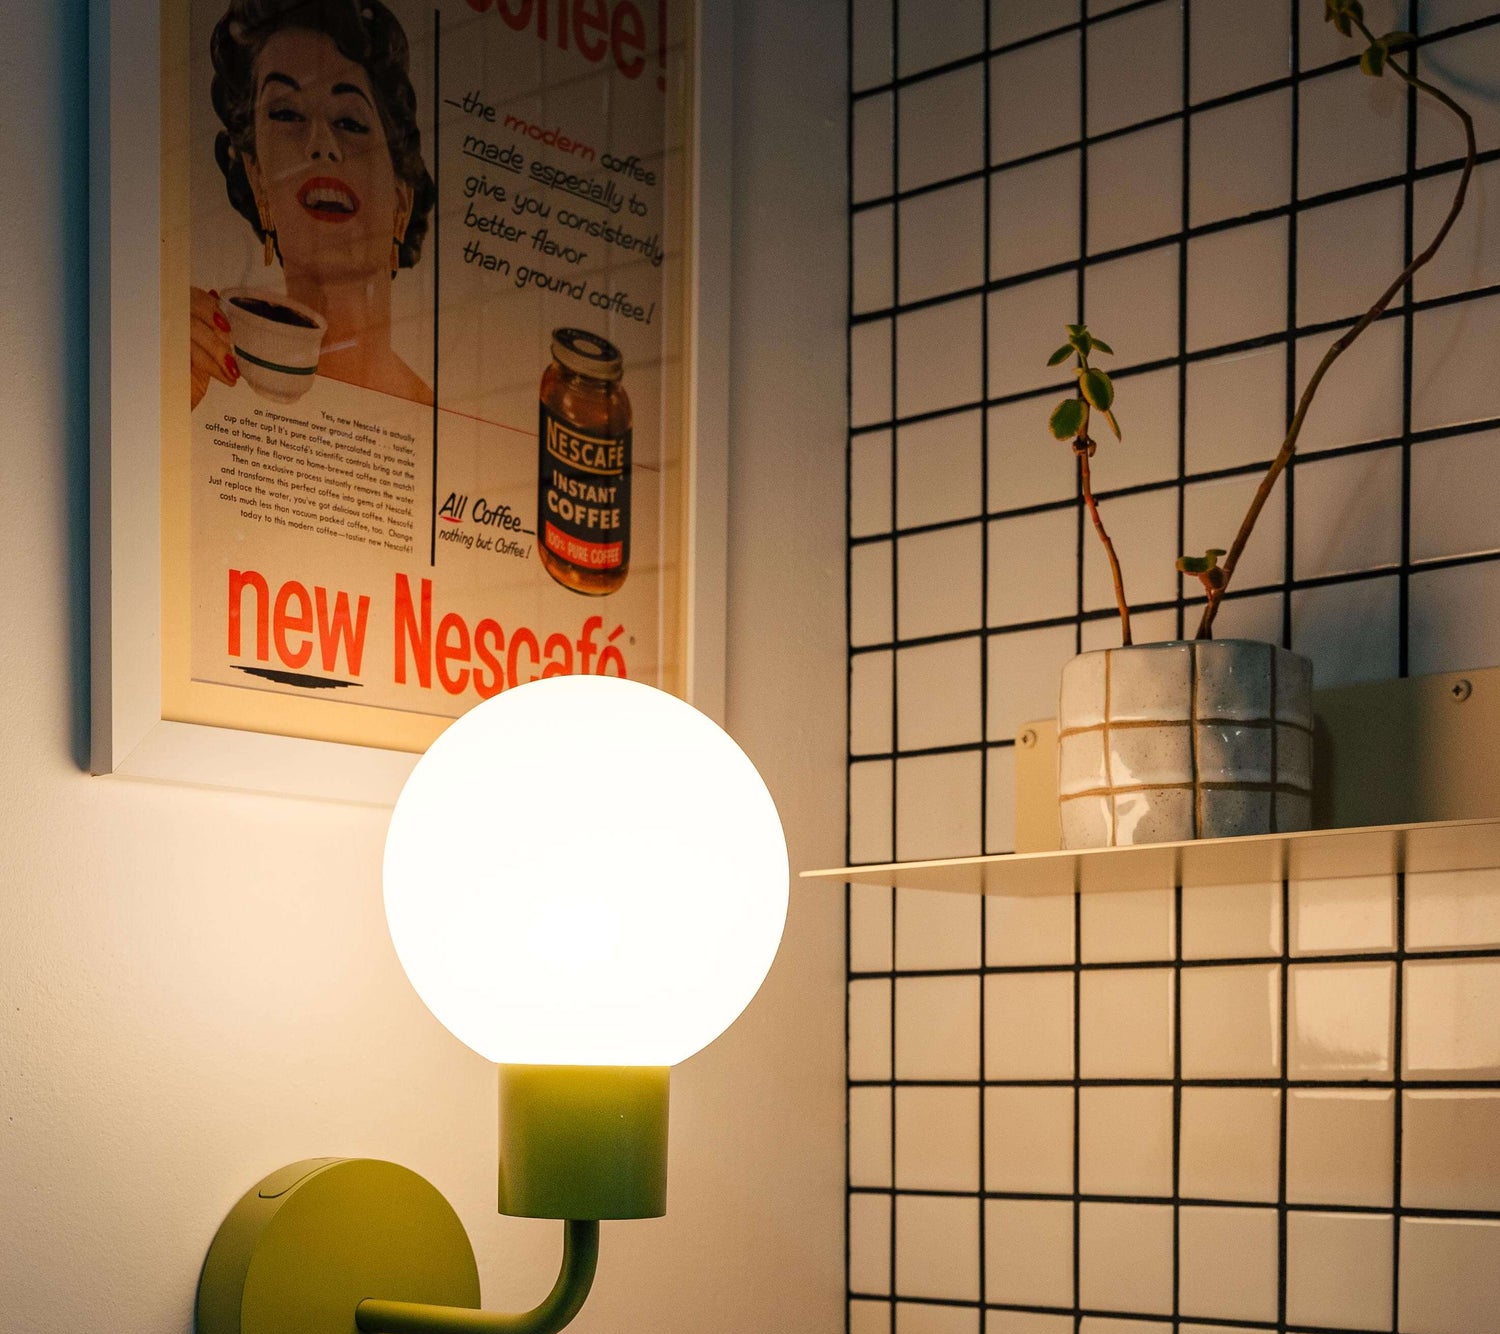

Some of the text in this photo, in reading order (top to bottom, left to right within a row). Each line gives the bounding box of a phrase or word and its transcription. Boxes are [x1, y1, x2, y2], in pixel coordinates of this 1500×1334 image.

[504, 114, 597, 162] modern
[601, 153, 657, 186] coffee
[463, 134, 648, 217] made especially to
[463, 175, 665, 267] give you consistently
[463, 202, 588, 265] better flavor
[463, 240, 656, 325] than ground coffee!
[205, 423, 229, 434] coffee
[242, 431, 264, 442] home.
[266, 436, 277, 445] But
[315, 450, 344, 463] scientific
[346, 457, 370, 469] controls
[373, 463, 390, 476] bring
[405, 471, 414, 479] the
[224, 415, 237, 424] cup
[240, 418, 257, 427] after
[260, 424, 276, 432] cup!
[290, 431, 306, 440] pure
[309, 436, 333, 448] coffee,
[335, 442, 371, 456] percolated
[384, 455, 395, 463] you
[397, 458, 415, 468] make
[265, 410, 309, 427] improvement
[311, 423, 327, 432] over
[329, 428, 352, 439] ground
[355, 435, 376, 445] coffee
[321, 410, 335, 423] Yes,
[337, 417, 351, 425] new
[390, 431, 415, 444] actually
[546, 416, 625, 469] NESCAFÉ
[213, 439, 254, 455] consistently
[257, 447, 270, 457] fine
[273, 450, 294, 463] flavor
[307, 459, 353, 477] home-brewed
[356, 472, 377, 482] coffee
[379, 479, 391, 487] can
[221, 467, 235, 475] and
[238, 470, 275, 484] transforms
[277, 478, 288, 487] this
[291, 482, 315, 493] perfect
[318, 488, 340, 499] coffee
[342, 494, 355, 503] into
[357, 499, 374, 507] gems
[232, 454, 248, 465] Then
[263, 463, 294, 476] exclusive
[297, 471, 322, 482] process
[324, 477, 351, 491] instantly
[354, 485, 381, 496] removes
[383, 491, 393, 499] the
[396, 496, 414, 504] water
[553, 469, 617, 504] INSTANT
[209, 475, 222, 486] Just
[225, 482, 253, 493] replace
[255, 487, 266, 495] the
[319, 502, 330, 510] got
[332, 504, 360, 517] delicious
[362, 512, 385, 523] coffee.
[387, 517, 413, 529] Nescafé
[220, 493, 413, 542] costs much less than vacuum packed coffee, too. Change
[240, 509, 262, 522] today
[265, 515, 272, 523] to
[274, 516, 286, 526] this
[288, 520, 314, 531] modern
[438, 492, 468, 520] All
[547, 490, 621, 529] COFFEE
[439, 527, 532, 559] nothing but Coffee!
[567, 541, 588, 562] PURE
[590, 547, 619, 564] COFFEE
[228, 569, 371, 677] new
